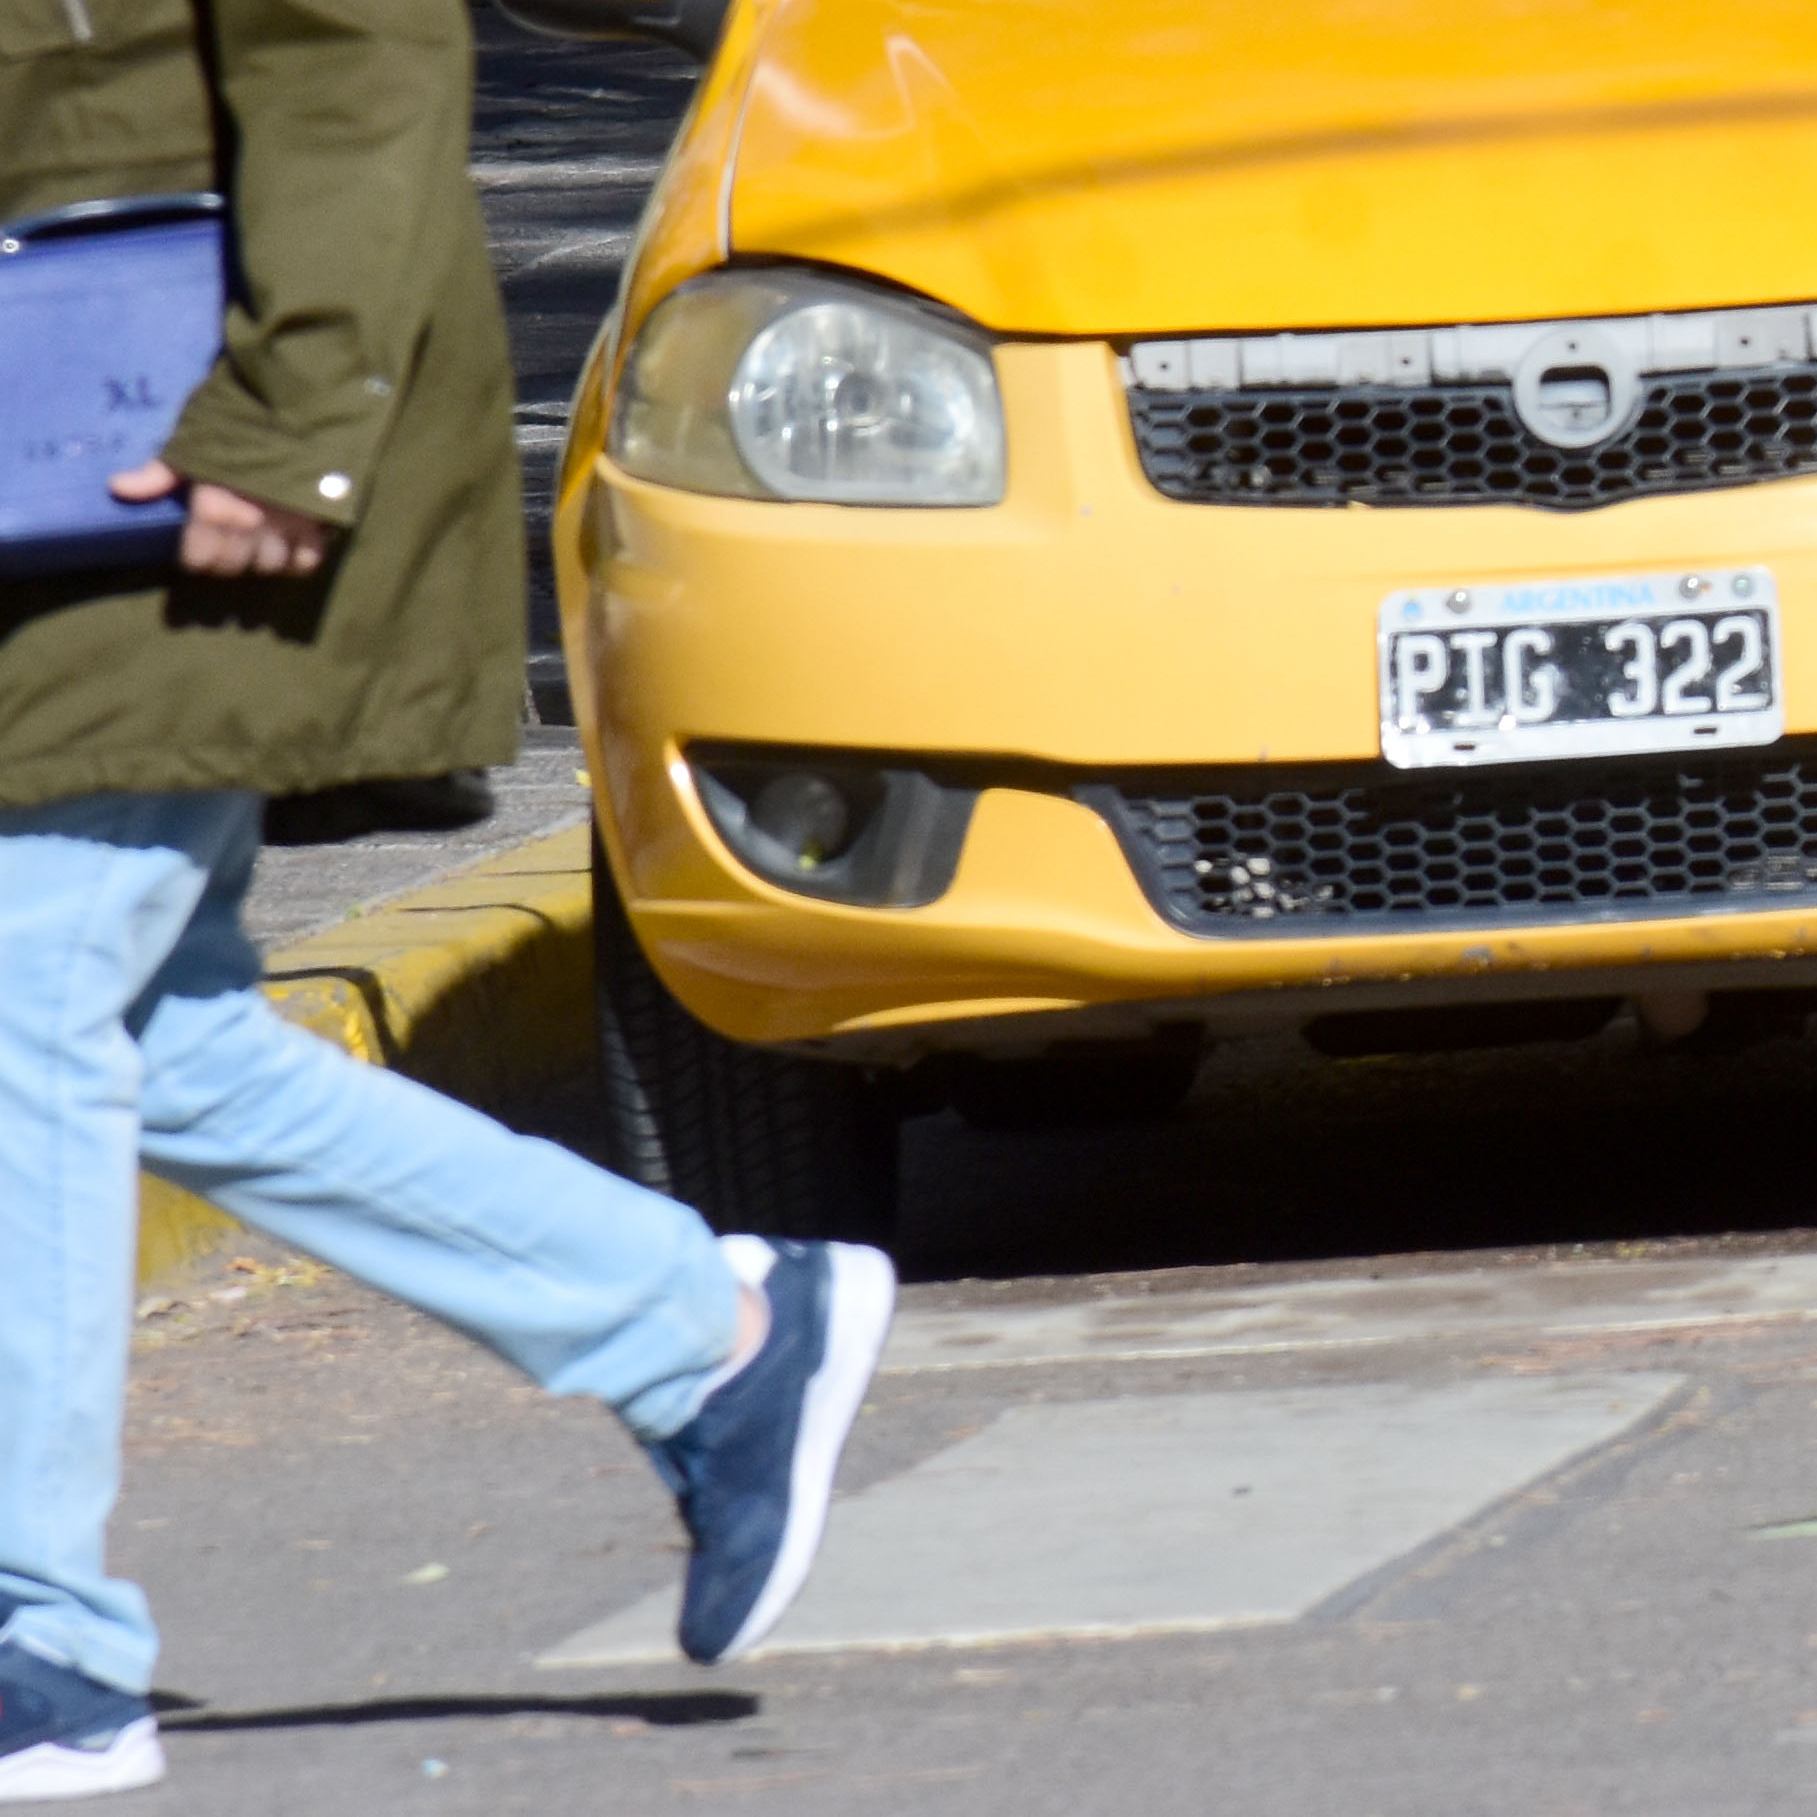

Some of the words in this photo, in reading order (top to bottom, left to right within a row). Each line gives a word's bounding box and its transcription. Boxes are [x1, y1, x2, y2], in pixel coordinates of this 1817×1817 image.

[1503, 583, 1656, 614] ARGENTINA
[1396, 627, 1559, 731] PIG
[1603, 614, 1771, 718] 322
